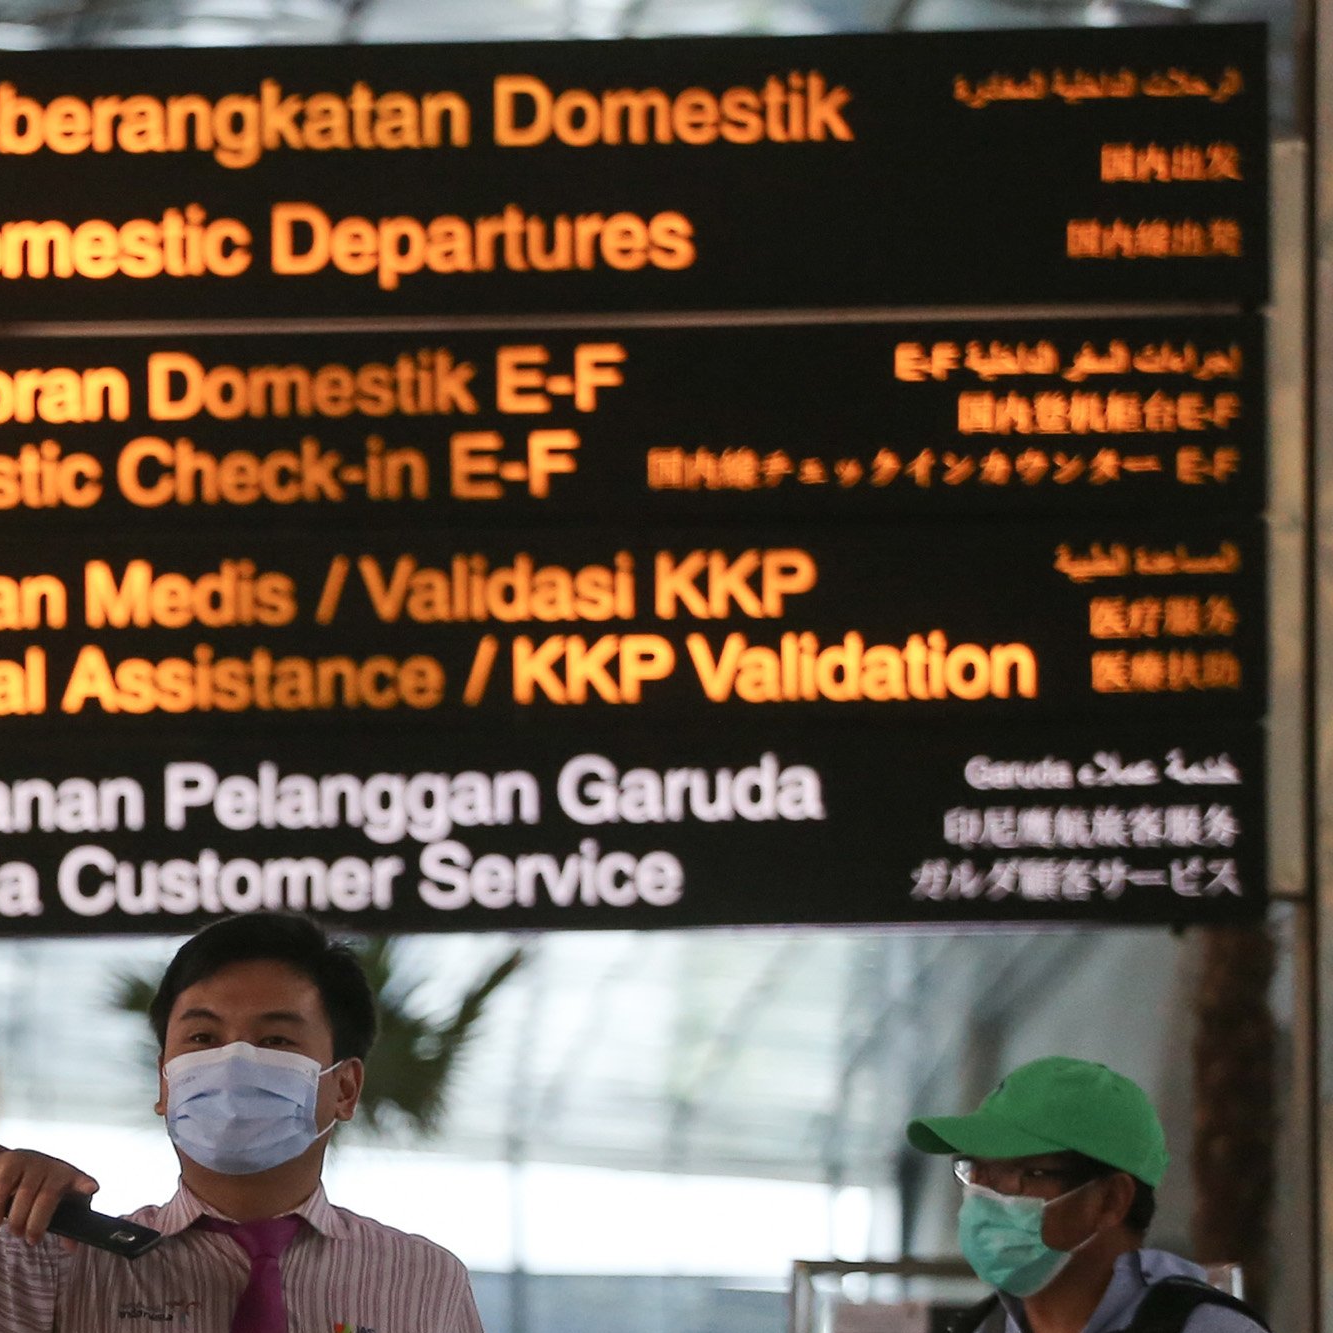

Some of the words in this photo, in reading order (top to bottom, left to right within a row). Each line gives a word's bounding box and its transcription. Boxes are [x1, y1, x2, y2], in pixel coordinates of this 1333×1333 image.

[493, 71, 853, 147] Domestik
[271, 202, 696, 291] Departures
[147, 349, 478, 421] Domestik
[496, 343, 627, 414] E-F
[116, 436, 428, 508] Check-in
[450, 429, 581, 499] E-F
[84, 559, 297, 629] Medis
[358, 551, 636, 623] Validasi
[654, 548, 817, 620] KKP
[60, 644, 445, 714] Assistance
[512, 633, 677, 705] KKP
[685, 629, 1038, 703] Validation
[164, 761, 540, 843] Pelanggan
[557, 752, 825, 825] Garuda
[965, 756, 1073, 790] Garuda
[58, 844, 404, 916] Customer
[418, 839, 684, 910] Service
